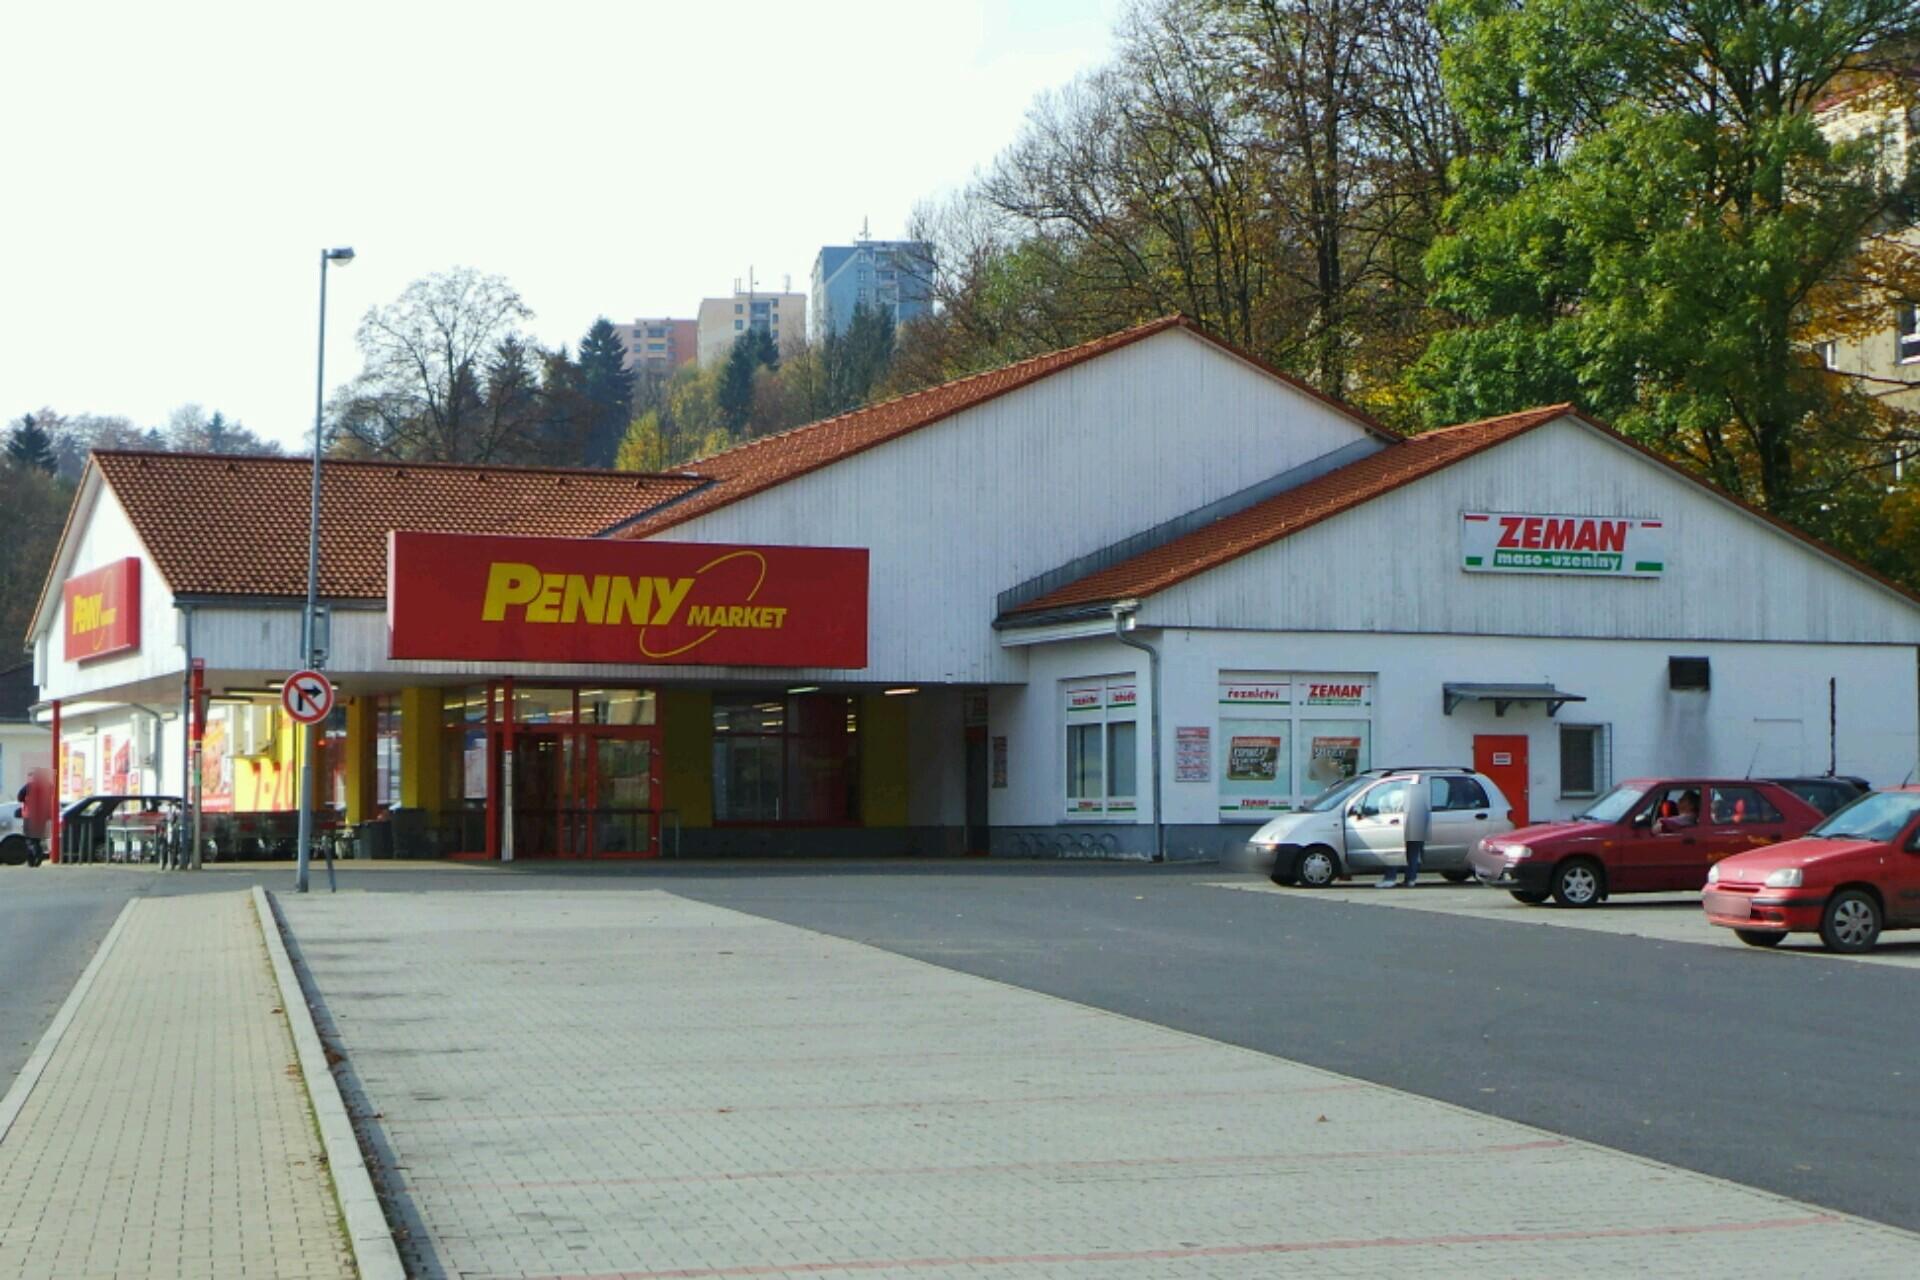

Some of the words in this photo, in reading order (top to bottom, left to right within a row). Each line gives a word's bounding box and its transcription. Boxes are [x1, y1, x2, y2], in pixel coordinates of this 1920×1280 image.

[1497, 517, 1627, 552] ZEMAN
[481, 562, 695, 627] PENNY
[687, 605, 787, 629] MARKET
[1309, 684, 1363, 698] ZEMAN
